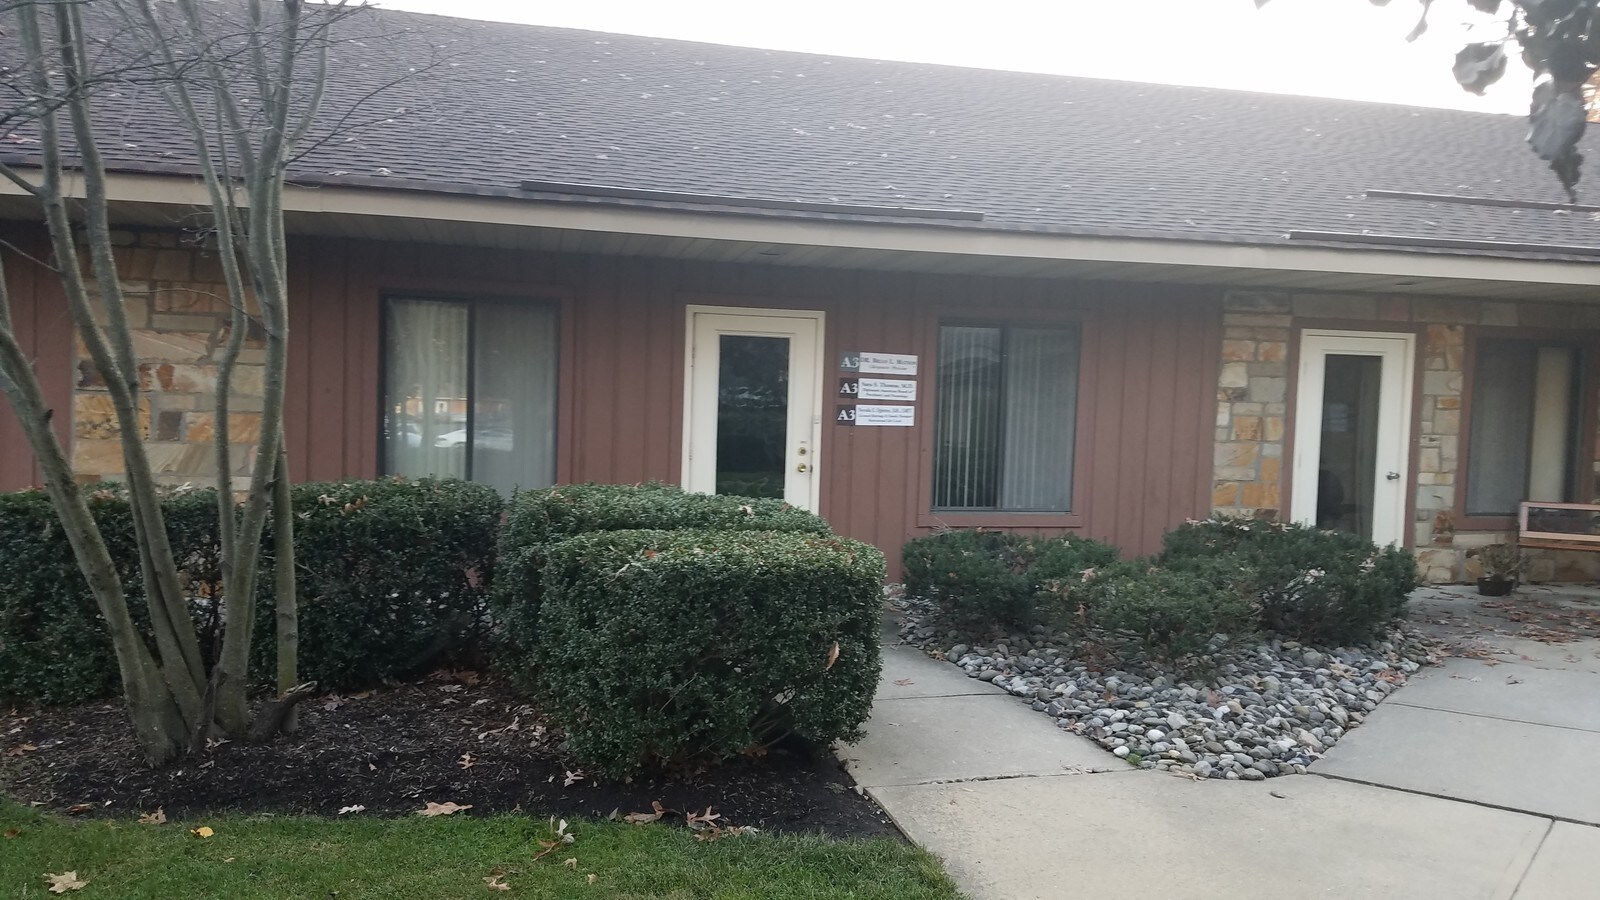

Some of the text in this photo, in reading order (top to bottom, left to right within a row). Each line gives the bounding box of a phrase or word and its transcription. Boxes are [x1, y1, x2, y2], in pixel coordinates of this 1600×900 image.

[841, 356, 860, 368] A3
[840, 382, 858, 394] A3
[837, 409, 855, 421] A3
